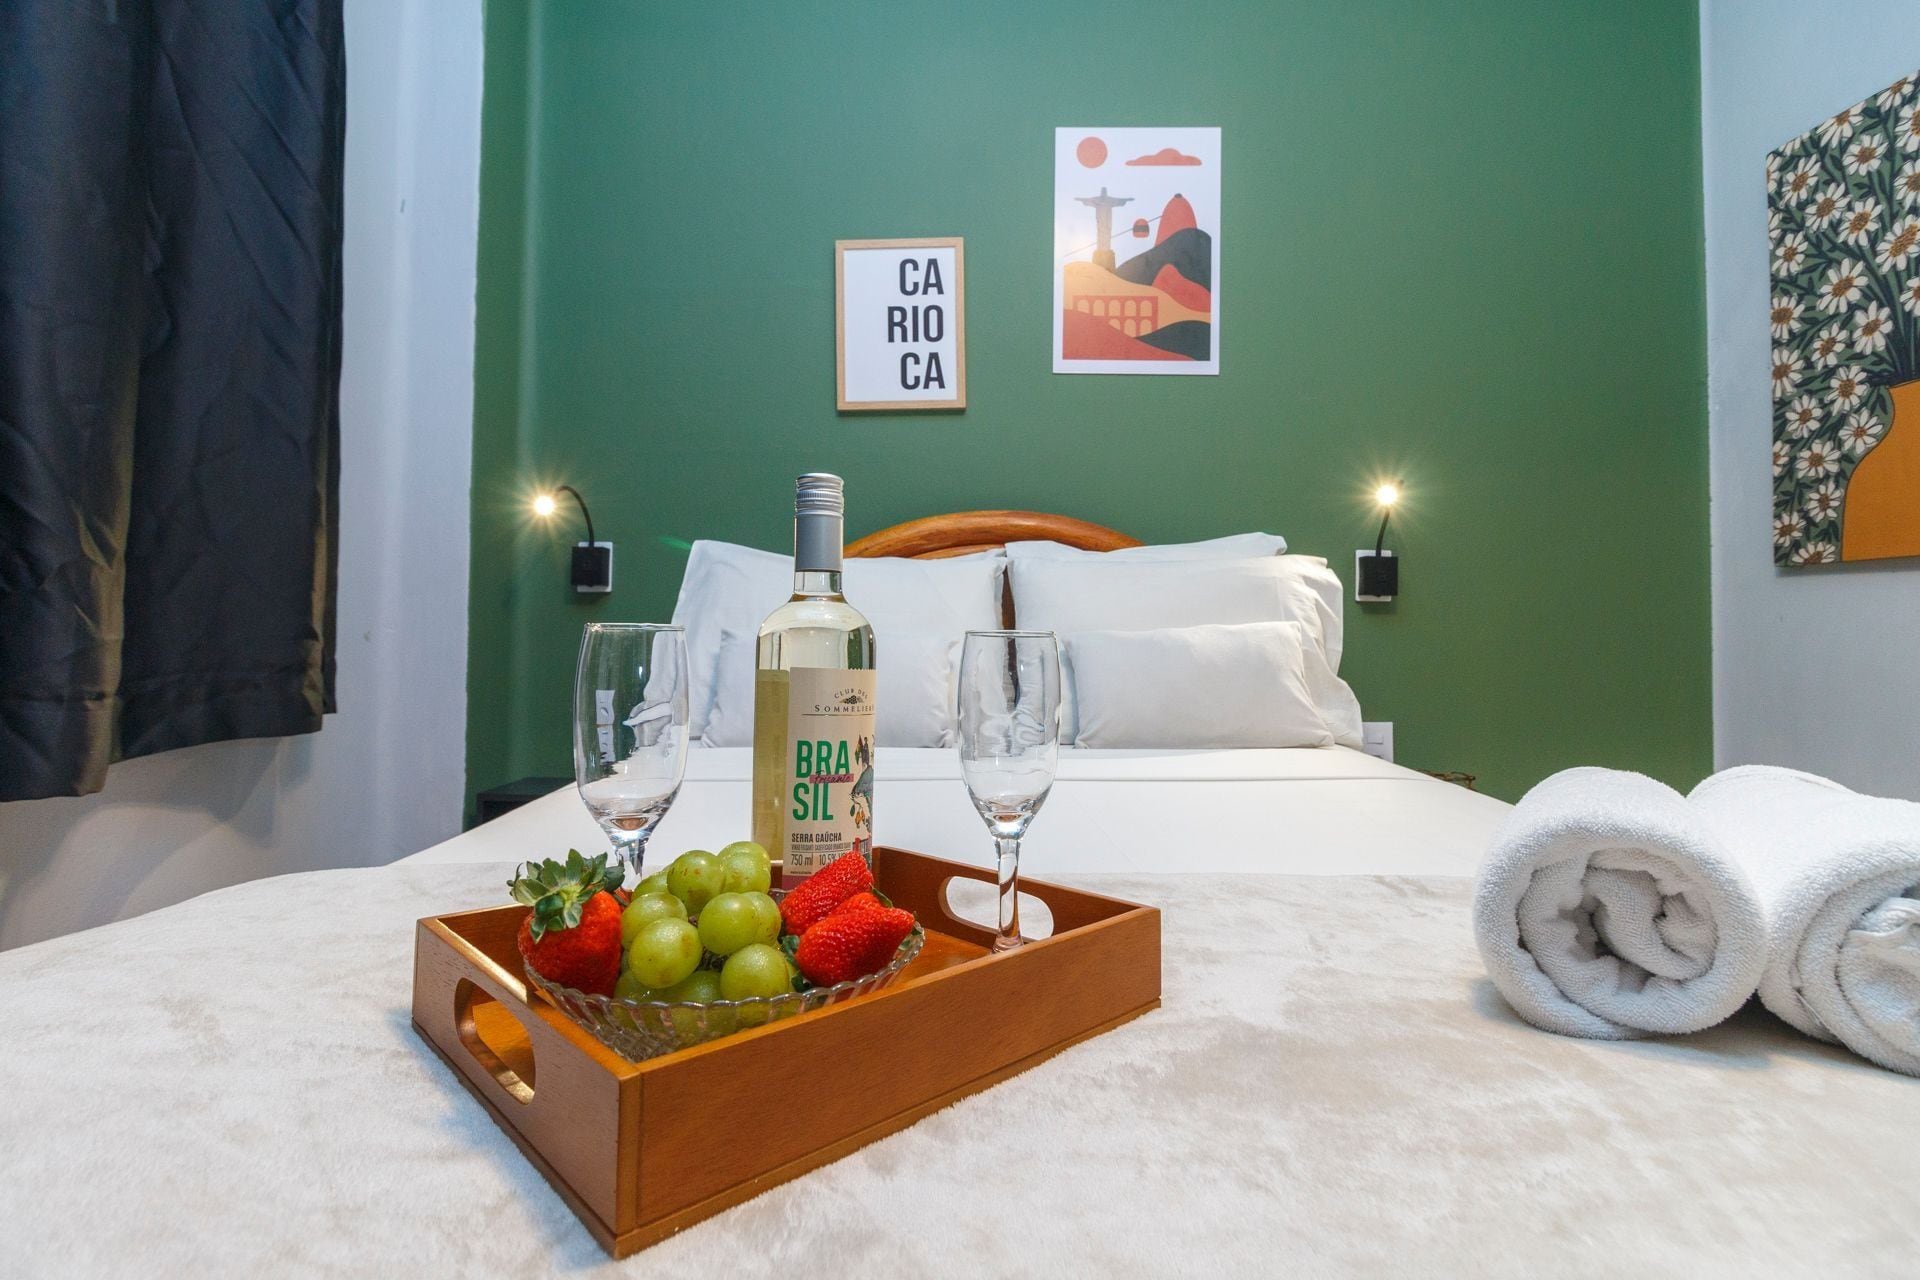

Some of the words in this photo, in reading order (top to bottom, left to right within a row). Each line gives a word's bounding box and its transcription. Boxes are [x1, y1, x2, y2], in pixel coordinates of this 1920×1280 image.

[899, 258, 944, 296] CA
[887, 305, 944, 343] RIO
[900, 352, 946, 390] CA
[834, 688, 854, 699] CLUB
[796, 740, 850, 778] BRA
[792, 782, 834, 821] SIL
[791, 832, 814, 843] SERRA
[815, 831, 842, 843] GAÚCHA
[791, 853, 802, 866] 750
